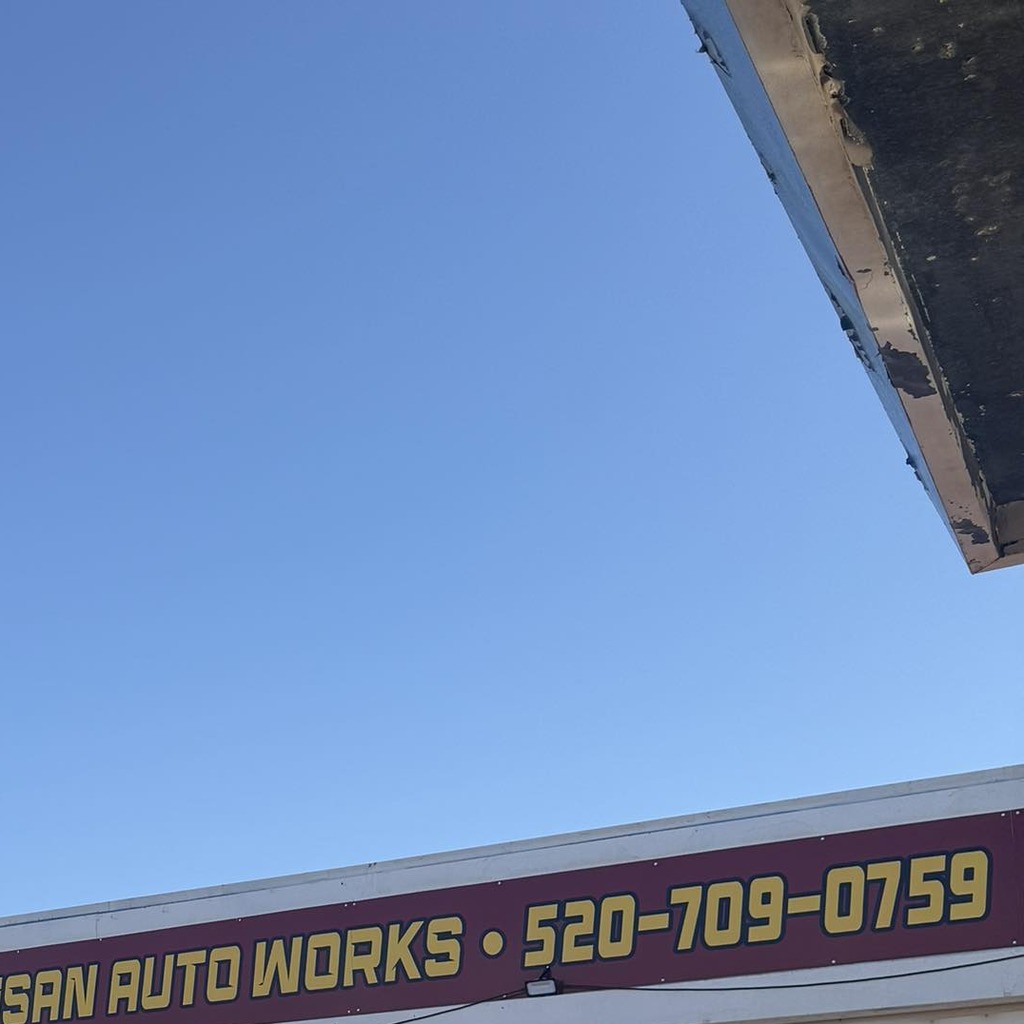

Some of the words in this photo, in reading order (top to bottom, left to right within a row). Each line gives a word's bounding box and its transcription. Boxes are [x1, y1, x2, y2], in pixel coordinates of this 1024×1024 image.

[107, 945, 241, 1014] AUTO
[251, 917, 463, 998] WORKS
[523, 850, 989, 968] 520-709-0759
